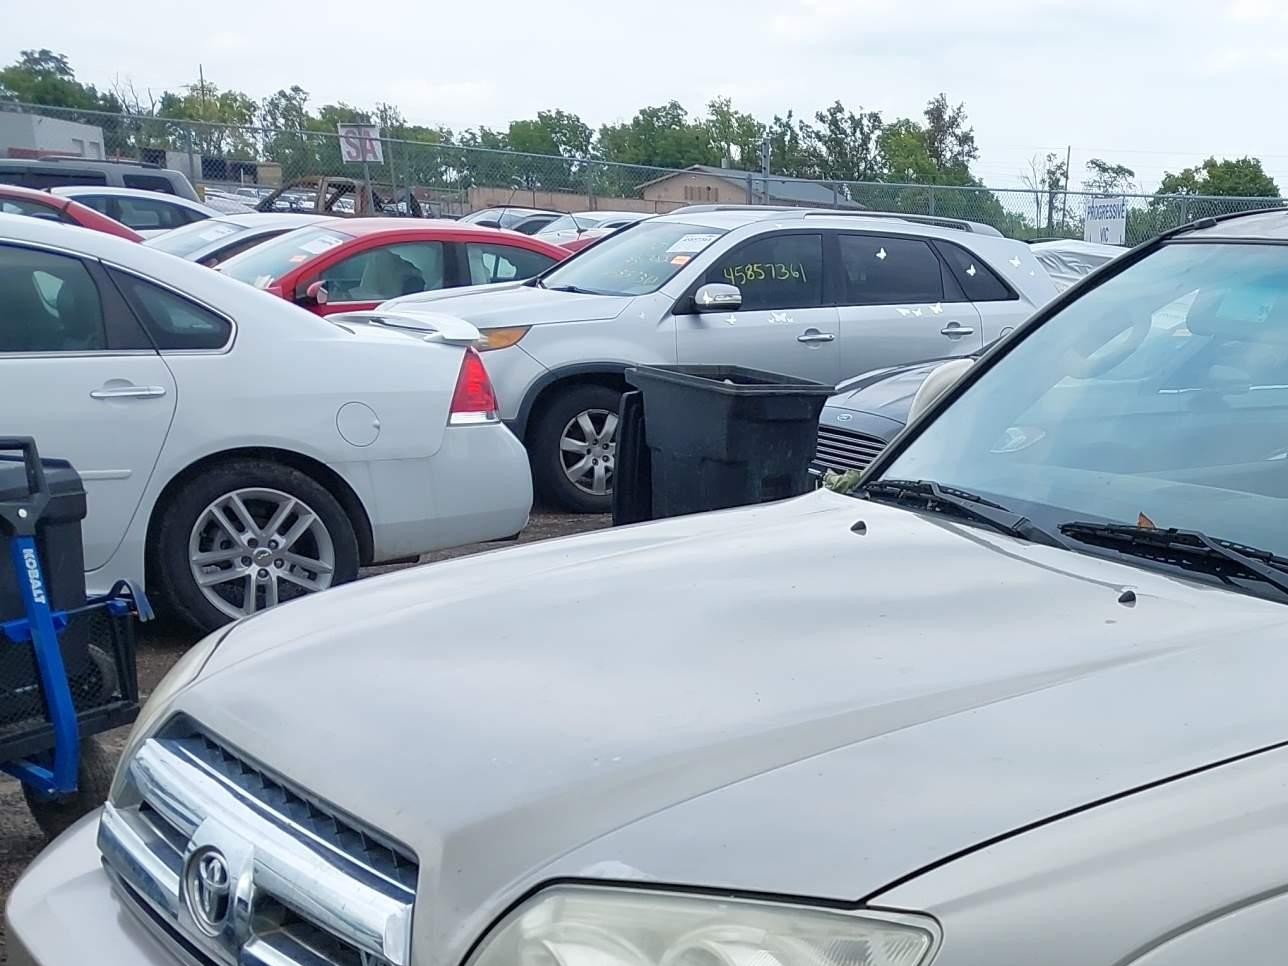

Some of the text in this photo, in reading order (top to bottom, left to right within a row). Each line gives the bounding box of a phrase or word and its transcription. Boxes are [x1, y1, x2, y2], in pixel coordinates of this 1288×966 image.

[1087, 203, 1125, 221] PROGRESSIVE
[723, 262, 807, 285] 45857361
[22, 548, 46, 604] KOBALT
